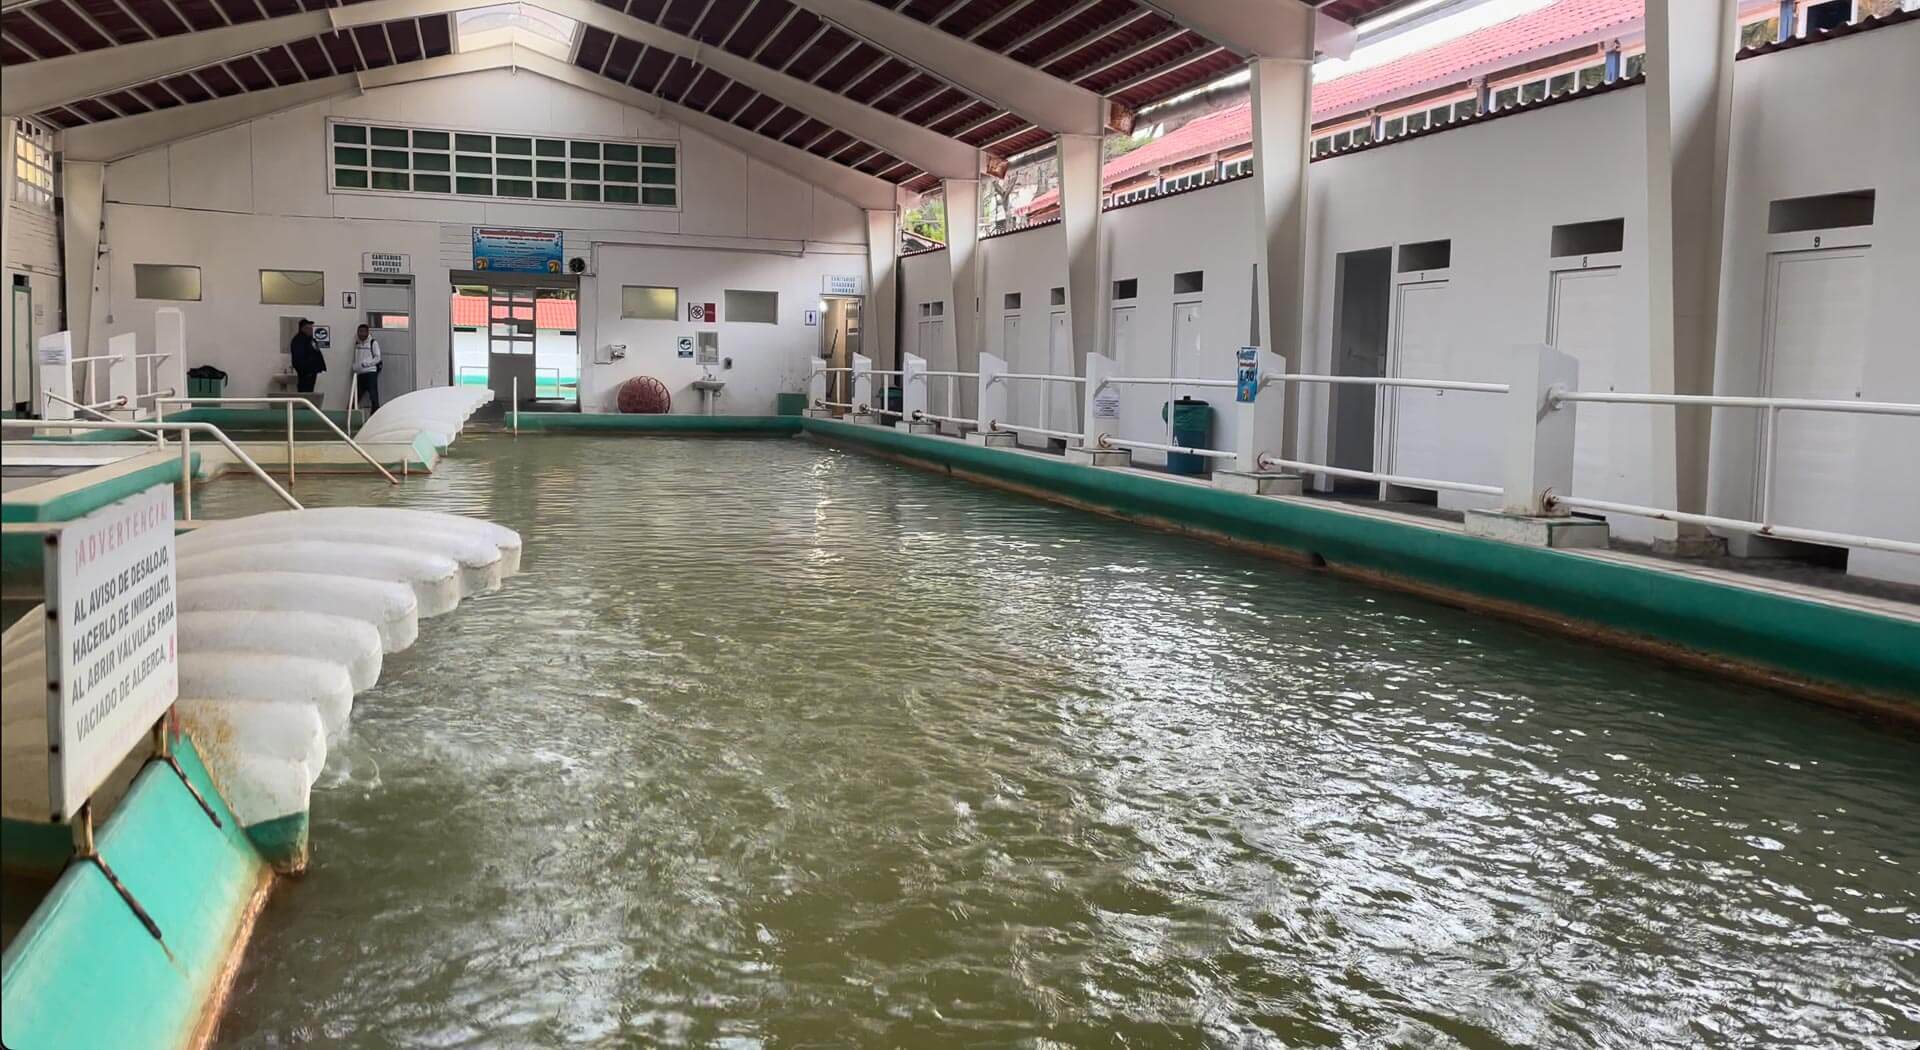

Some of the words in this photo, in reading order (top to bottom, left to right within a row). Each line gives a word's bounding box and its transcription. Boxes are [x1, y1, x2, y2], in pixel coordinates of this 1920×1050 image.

[1814, 236, 1821, 248] 9
[74, 598, 87, 626] AL
[90, 578, 116, 616] AVISO
[119, 569, 129, 596] DE
[131, 546, 168, 587] DESALOJO,
[72, 675, 85, 706] AL
[88, 649, 115, 692] ABRIR
[158, 600, 174, 631] PARA
[73, 613, 116, 667] HACERLO
[119, 602, 129, 632] DE
[77, 688, 117, 742] VACIADO
[120, 674, 130, 702] DE
